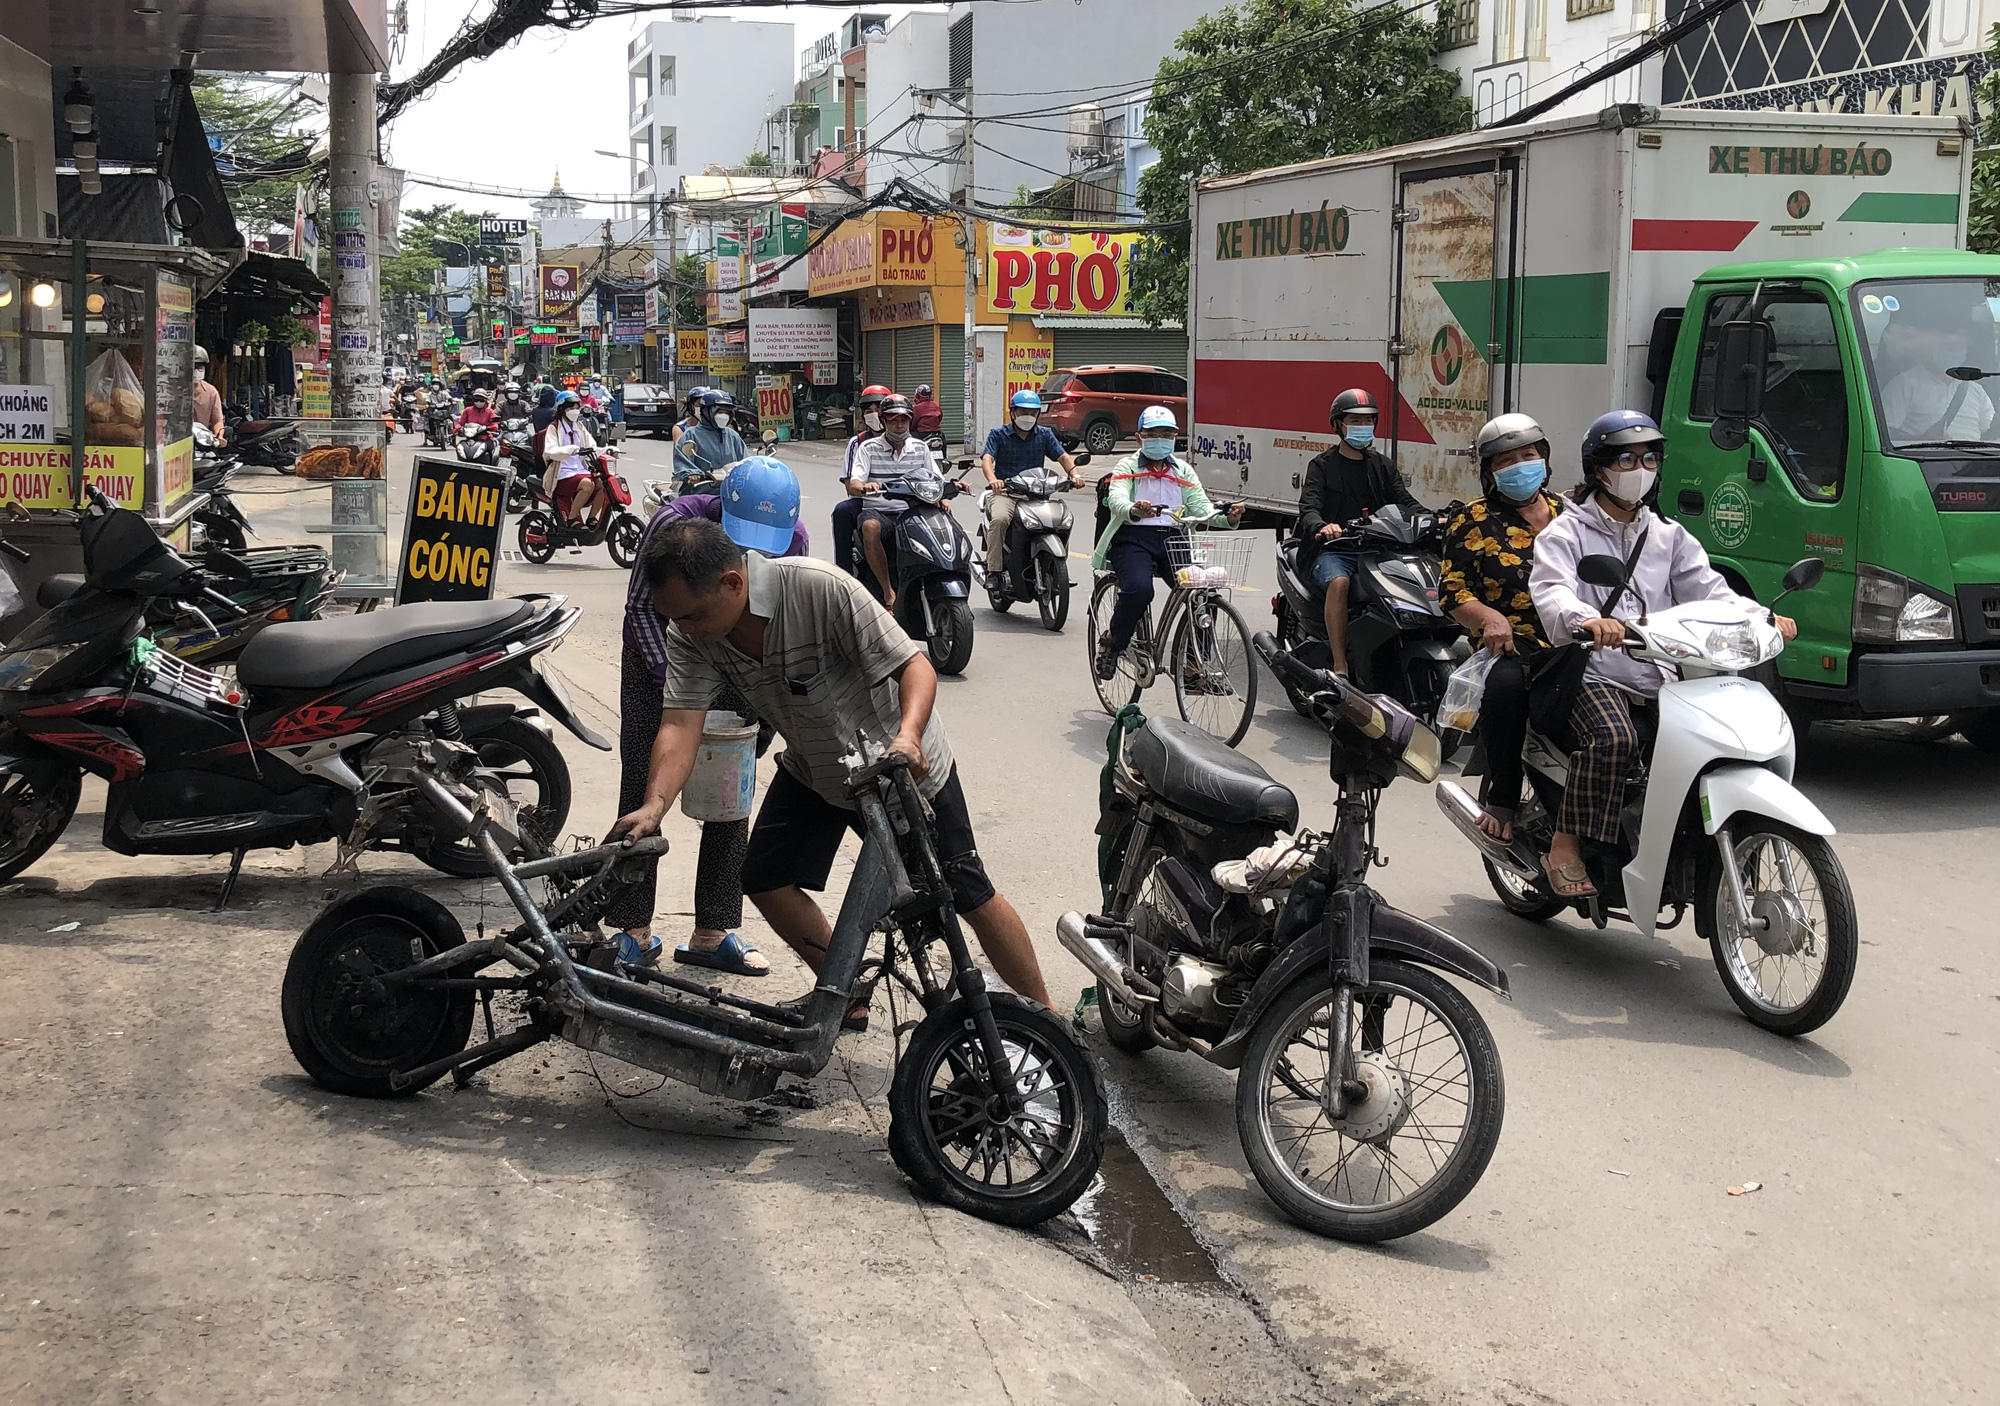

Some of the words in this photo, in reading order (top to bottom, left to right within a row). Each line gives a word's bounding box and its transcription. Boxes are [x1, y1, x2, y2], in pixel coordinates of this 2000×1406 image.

[1711, 146, 1749, 173] XE
[1760, 144, 1823, 175] THƯ
[1830, 141, 1892, 176] BÁO
[482, 220, 526, 233] HOTEL
[1217, 221, 1242, 260] XE
[1250, 208, 1294, 256] THƯ
[1299, 199, 1350, 252] BÁO
[881, 215, 933, 264] PHỞ
[883, 265, 898, 280] BẢO
[900, 269, 926, 280] TRANG
[992, 232, 1122, 312] PHỞ
[545, 290, 560, 300] SAN
[561, 290, 577, 300] SAN
[680, 335, 697, 350] BÚN
[684, 350, 697, 360] Cô
[1009, 345, 1025, 359] BẢO
[1027, 348, 1051, 360] TRANG
[1008, 361, 1032, 373] Chuyên
[0, 389, 48, 412] KHOẢNG
[758, 376, 791, 417] PHỞ
[1417, 397, 1488, 412] ADDED-VALUE
[21, 423, 46, 440] 2M
[1273, 438, 1289, 448] ADV
[1290, 439, 1325, 453] EXPRESS
[0, 449, 71, 468] CHUYÊN
[83, 450, 115, 469] BÁN
[13, 473, 52, 503] QUAY
[67, 475, 90, 500] VT
[95, 475, 135, 501] QUAY
[416, 472, 500, 527] BÁNH
[1940, 492, 1987, 501] TURBO
[1804, 534, 1844, 547] ISUZU
[1805, 545, 1843, 556] DI-TURBO
[409, 532, 490, 588] CÓNG
